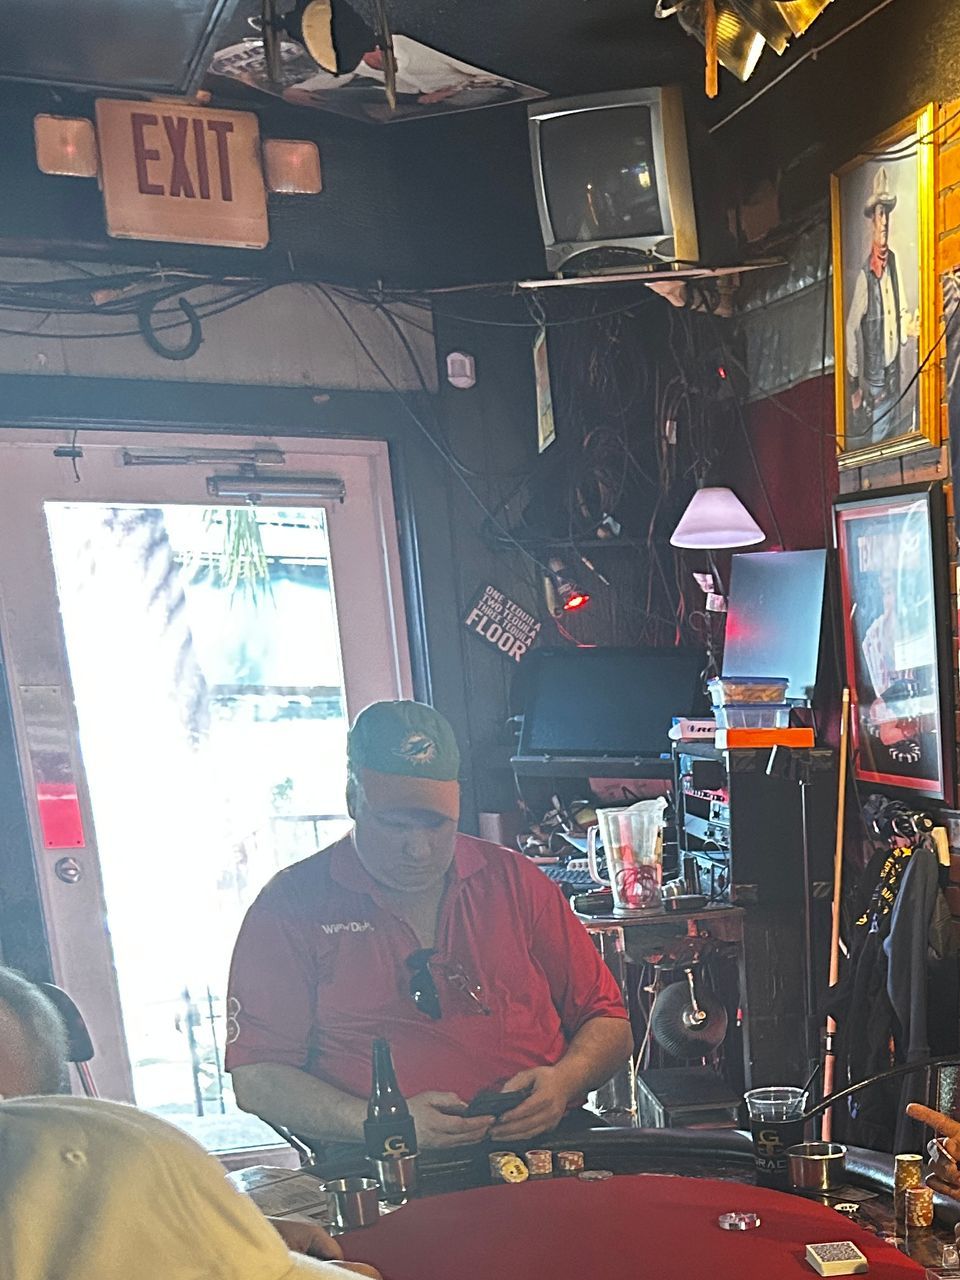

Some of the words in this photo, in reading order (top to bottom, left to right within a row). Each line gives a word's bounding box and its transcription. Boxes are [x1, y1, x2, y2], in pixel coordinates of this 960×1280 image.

[130, 111, 234, 201] EXIT
[477, 600, 502, 624] THREE
[501, 618, 533, 647] TEQUILA
[482, 593, 504, 613] TWO
[502, 608, 537, 640] TEQUILA
[485, 585, 505, 602] ONE
[505, 599, 542, 632] TEQUILA
[464, 607, 527, 662] FLOOR
